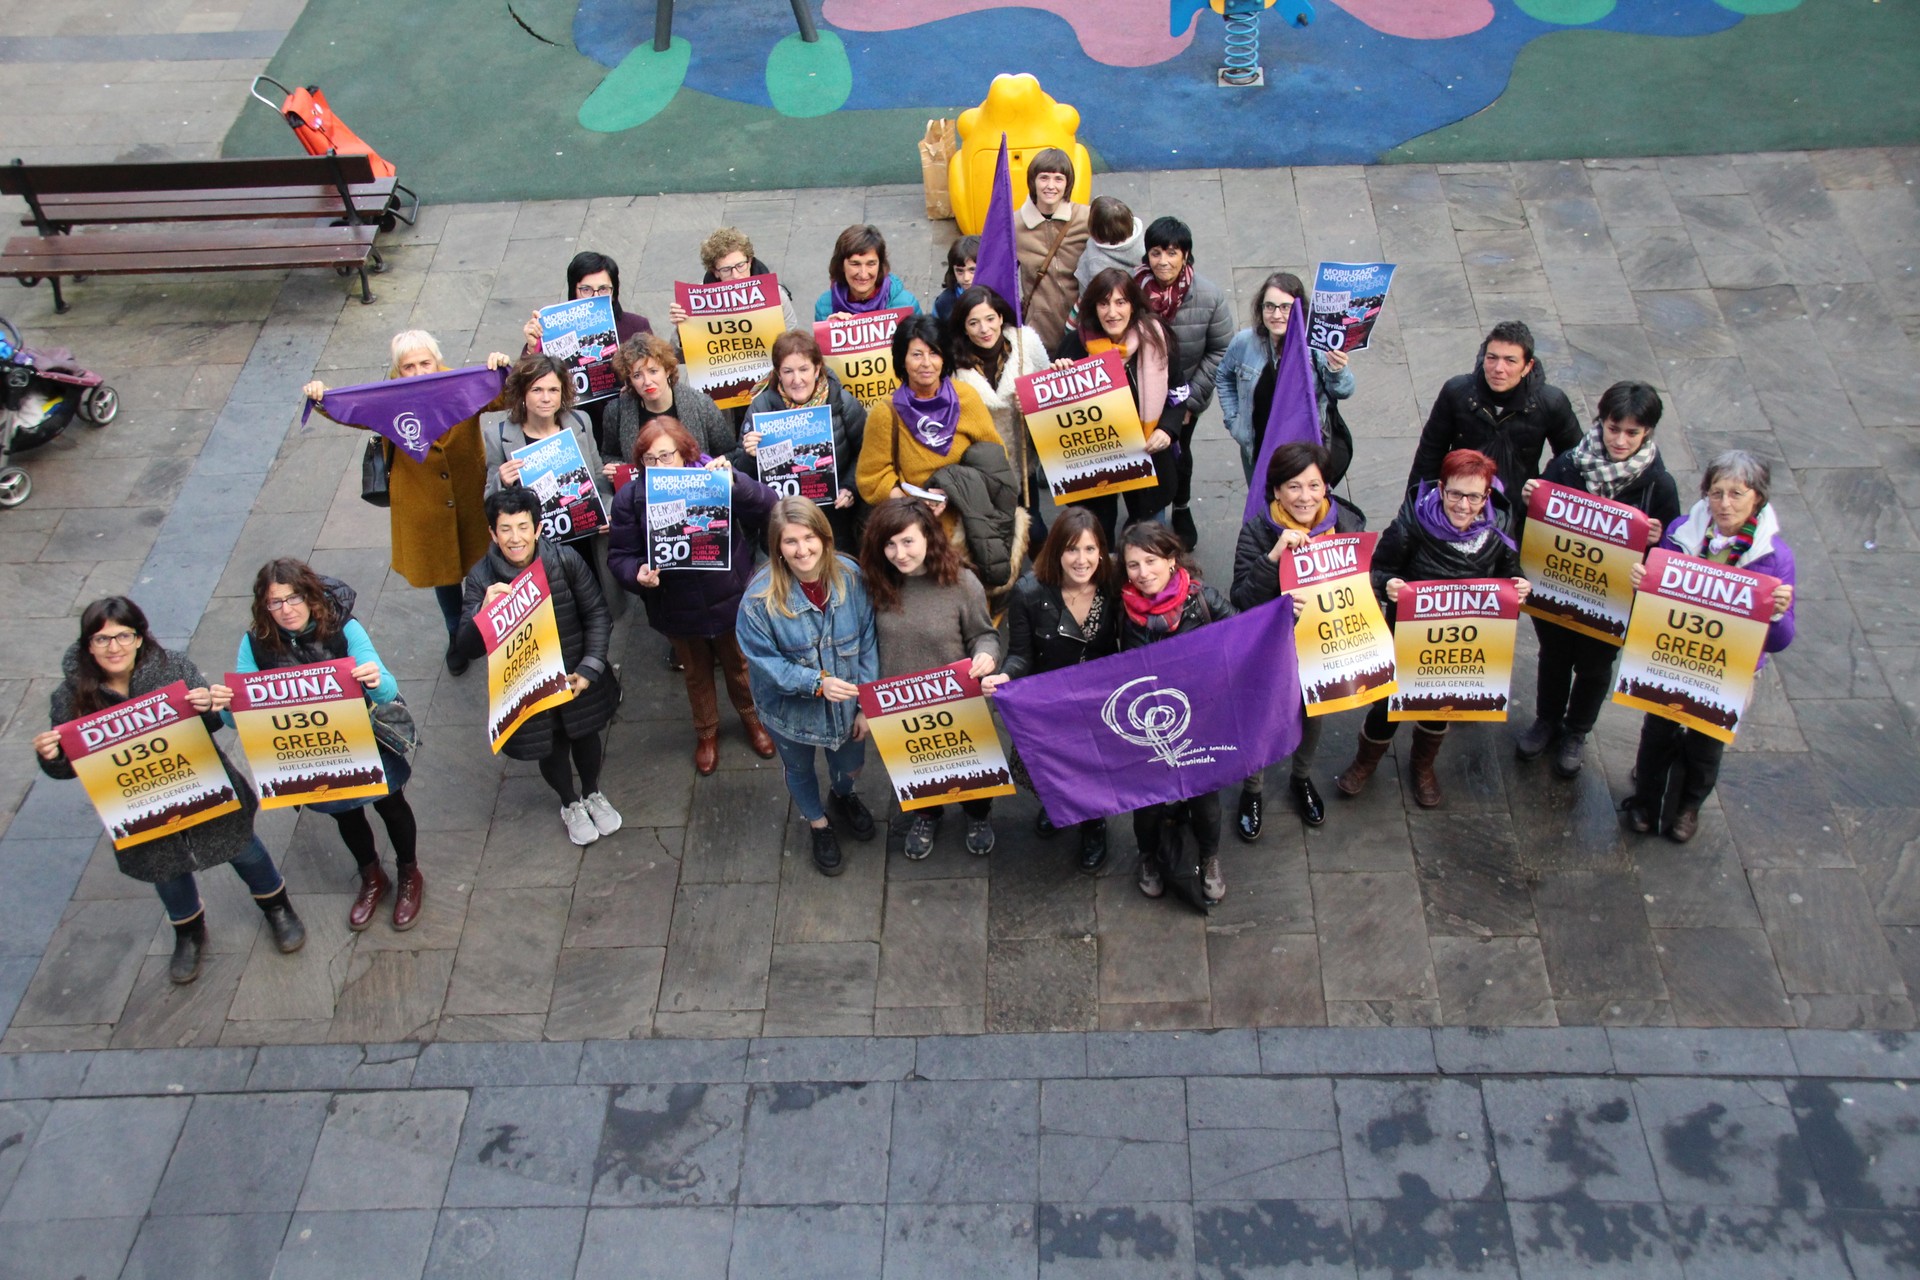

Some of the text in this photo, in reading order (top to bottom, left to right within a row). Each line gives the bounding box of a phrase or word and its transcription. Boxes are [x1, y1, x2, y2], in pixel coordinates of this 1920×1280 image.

[1323, 274, 1372, 282] OROKORRA
[1324, 266, 1379, 277] MOBILIZAZIO
[688, 280, 761, 294] LAN-PENTSIO-BIZITZA
[689, 286, 765, 310] DUINA
[543, 301, 594, 323] MOBILIZAZIO
[545, 310, 591, 328] OROKORRA
[830, 313, 898, 328] LAN-PENTSIO-BIZITZA
[707, 319, 752, 334] U30
[830, 320, 897, 348] DUINA
[1314, 318, 1347, 330] Urtarrilak
[707, 337, 765, 355] GREBA
[1310, 340, 1329, 351] Enero
[1312, 325, 1344, 350] 30
[709, 350, 767, 365] OROKORRA
[845, 357, 886, 378] U30
[710, 362, 770, 377] HUELGA GENERAL
[1031, 358, 1104, 385] LAN-PENTSIO-BIZITZA
[1033, 367, 1112, 404] DUINA
[760, 411, 813, 430] MOBILIZAZIO
[761, 419, 810, 436] OROKORRA
[1056, 406, 1103, 428] U30
[1059, 425, 1119, 449] GREBA
[1063, 440, 1123, 459] OROKORRA
[1066, 453, 1127, 470] HUELGA GENERAL
[653, 473, 711, 484] MOBILIZAZIO
[653, 481, 706, 491] OROKORRA
[765, 473, 798, 482] Urtarrilak
[541, 506, 568, 519] rtarrilak
[1551, 489, 1633, 519] LAN-PENTSIO-BIZITZA
[541, 513, 571, 539] 30
[1545, 496, 1629, 540] DUINA
[655, 534, 690, 542] Urtarrilak
[655, 541, 690, 564] 30
[1554, 535, 1604, 564] U30
[1293, 545, 1357, 578] DUINA
[1546, 554, 1608, 588] GREBA
[1667, 556, 1758, 586] LAN-PENTSIO-BIZITZA
[1416, 584, 1500, 594] LAN-PENTSIO-BIZITZA
[1540, 580, 1606, 608] HUELGA GENERAL
[1543, 568, 1607, 598] OROKORRA
[1660, 565, 1753, 609] DUINA
[491, 580, 542, 638] DUINA
[1317, 587, 1354, 613] U30
[1415, 592, 1500, 613] DUINA
[1658, 588, 1688, 600] SOBERANÍA
[1688, 595, 1701, 603] PARA
[1709, 601, 1730, 610] CAMBIO
[1731, 606, 1750, 615] SOCIAL
[1318, 612, 1370, 640] GREBA
[1427, 625, 1478, 644] U30
[1667, 609, 1723, 639] U30
[506, 623, 533, 660] U30
[1321, 631, 1376, 655] OROKORRA
[1656, 633, 1726, 667] GREBA
[503, 639, 540, 683] GREBA
[1323, 650, 1379, 671] HUELGA GENERAL
[1420, 648, 1486, 665] GREBA
[1652, 650, 1723, 679] OROKORRA
[244, 666, 336, 685] LAN-PENTSIO-BIZITZA
[503, 654, 541, 695] OROKORRA
[873, 669, 956, 691] LAN-PENTSIO-BIZITZA
[1417, 665, 1484, 675] OROKORRA
[1647, 666, 1721, 695] HUELGA GENERAL
[246, 674, 343, 703] DUINA
[876, 677, 963, 708] DUINA
[77, 693, 168, 731] LAN-PENTSIO-BIZITZA
[881, 704, 908, 713] SOBERANÍA
[80, 701, 177, 747] DUINA
[272, 710, 329, 731] U30
[902, 711, 954, 733] U30
[273, 730, 347, 750] GREBA
[905, 730, 973, 754] GREBA
[112, 737, 169, 767] U30
[276, 745, 350, 761] OROKORRA
[910, 745, 976, 764] OROKORRA
[117, 754, 190, 787] GREBA
[279, 758, 355, 771] HUELGA GENERAL
[913, 759, 982, 775] HUELGA GENERAL
[122, 768, 196, 798] OROKORRA
[127, 782, 203, 810] HUELGA GENERAL
